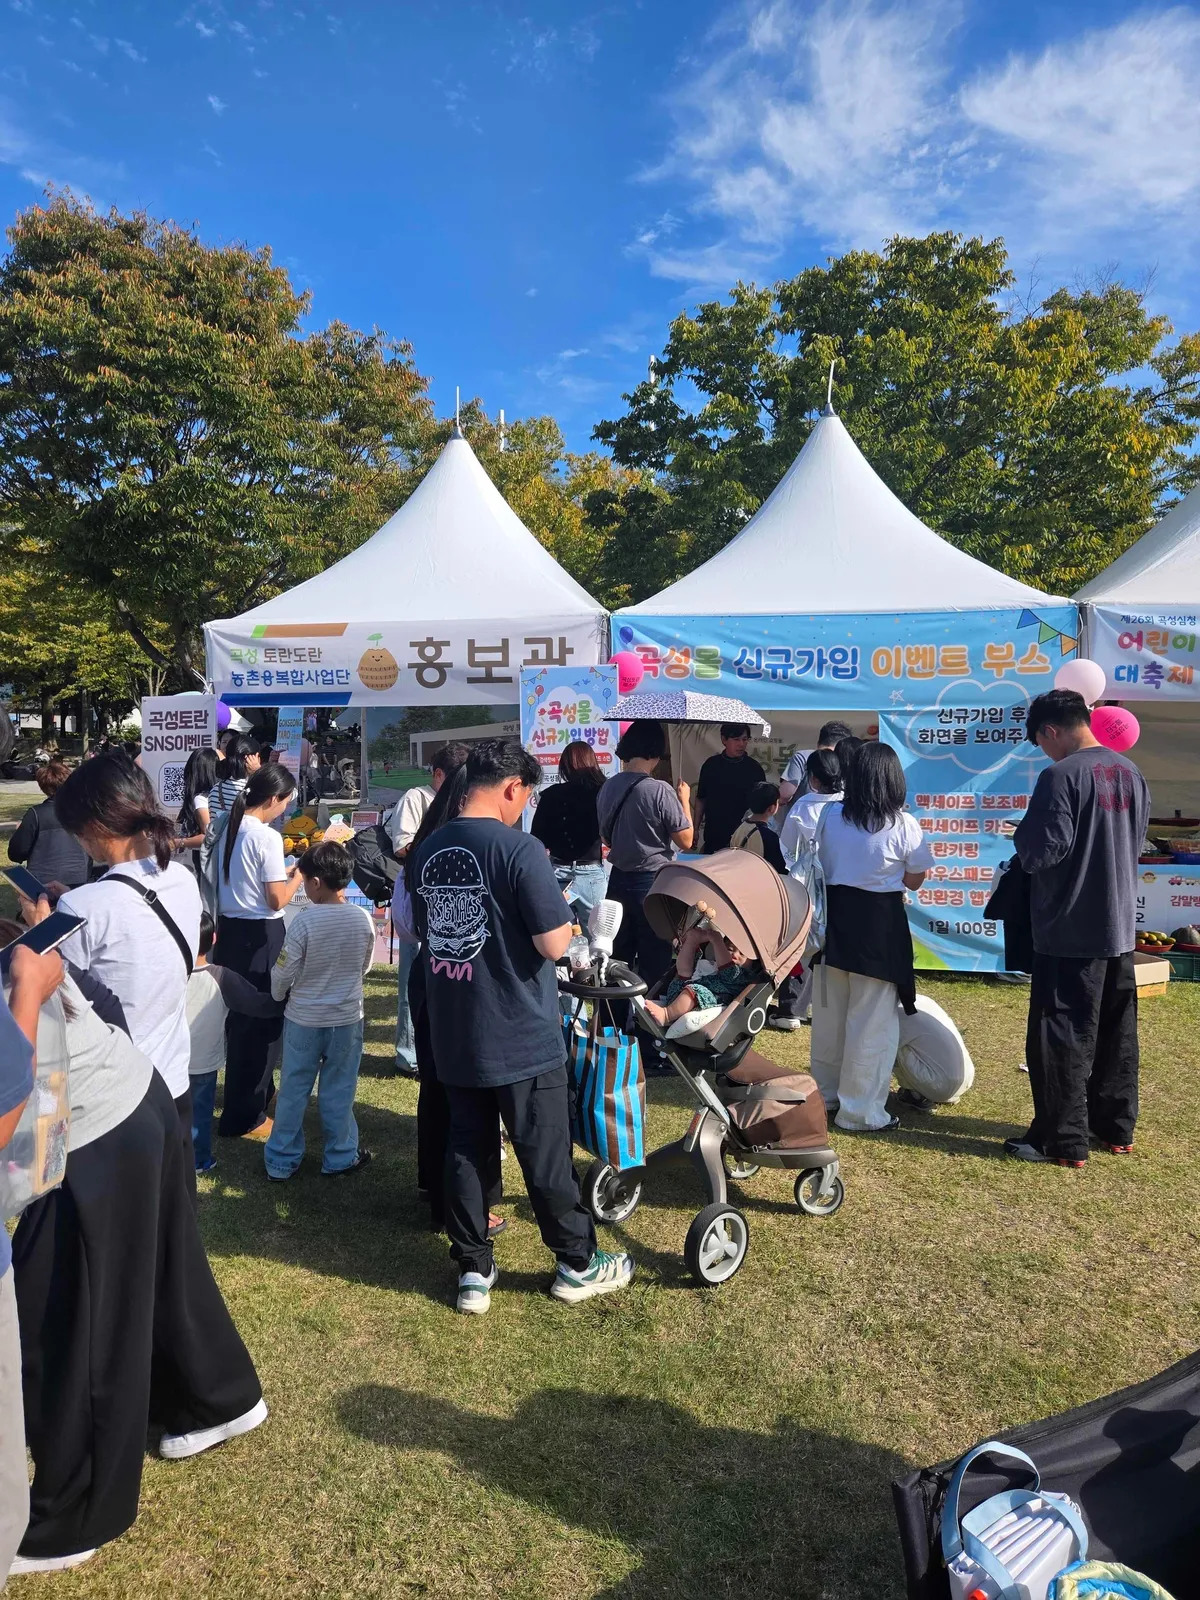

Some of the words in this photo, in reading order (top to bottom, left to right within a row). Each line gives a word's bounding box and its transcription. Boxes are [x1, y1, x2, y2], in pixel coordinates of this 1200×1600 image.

[1120, 615, 1154, 625] 제26회
[1158, 615, 1197, 626] 곡성심청
[1117, 630, 1196, 655] 어린이
[229, 648, 258, 665] 곡성
[263, 647, 323, 664] 토란도란
[635, 645, 722, 680] 곡성몰
[733, 645, 859, 681] 신규가입
[871, 645, 971, 679] 이벤트
[981, 642, 1053, 679] 부스
[1114, 660, 1194, 690] 대축제
[149, 709, 209, 731] 곡성토란
[547, 700, 592, 725] 곡성몰
[937, 707, 1003, 725] 신규가입
[1010, 706, 1027, 724] 후
[144, 733, 212, 752] SNS이벤트
[531, 728, 582, 748] 신규가입
[584, 727, 609, 747] 방법
[918, 728, 968, 745] 화면을
[916, 794, 975, 811] 맥세이프
[981, 795, 1032, 810] 보조배
[918, 889, 962, 905] 친환경
[928, 920, 949, 935] 1일
[955, 921, 997, 936] 100명
